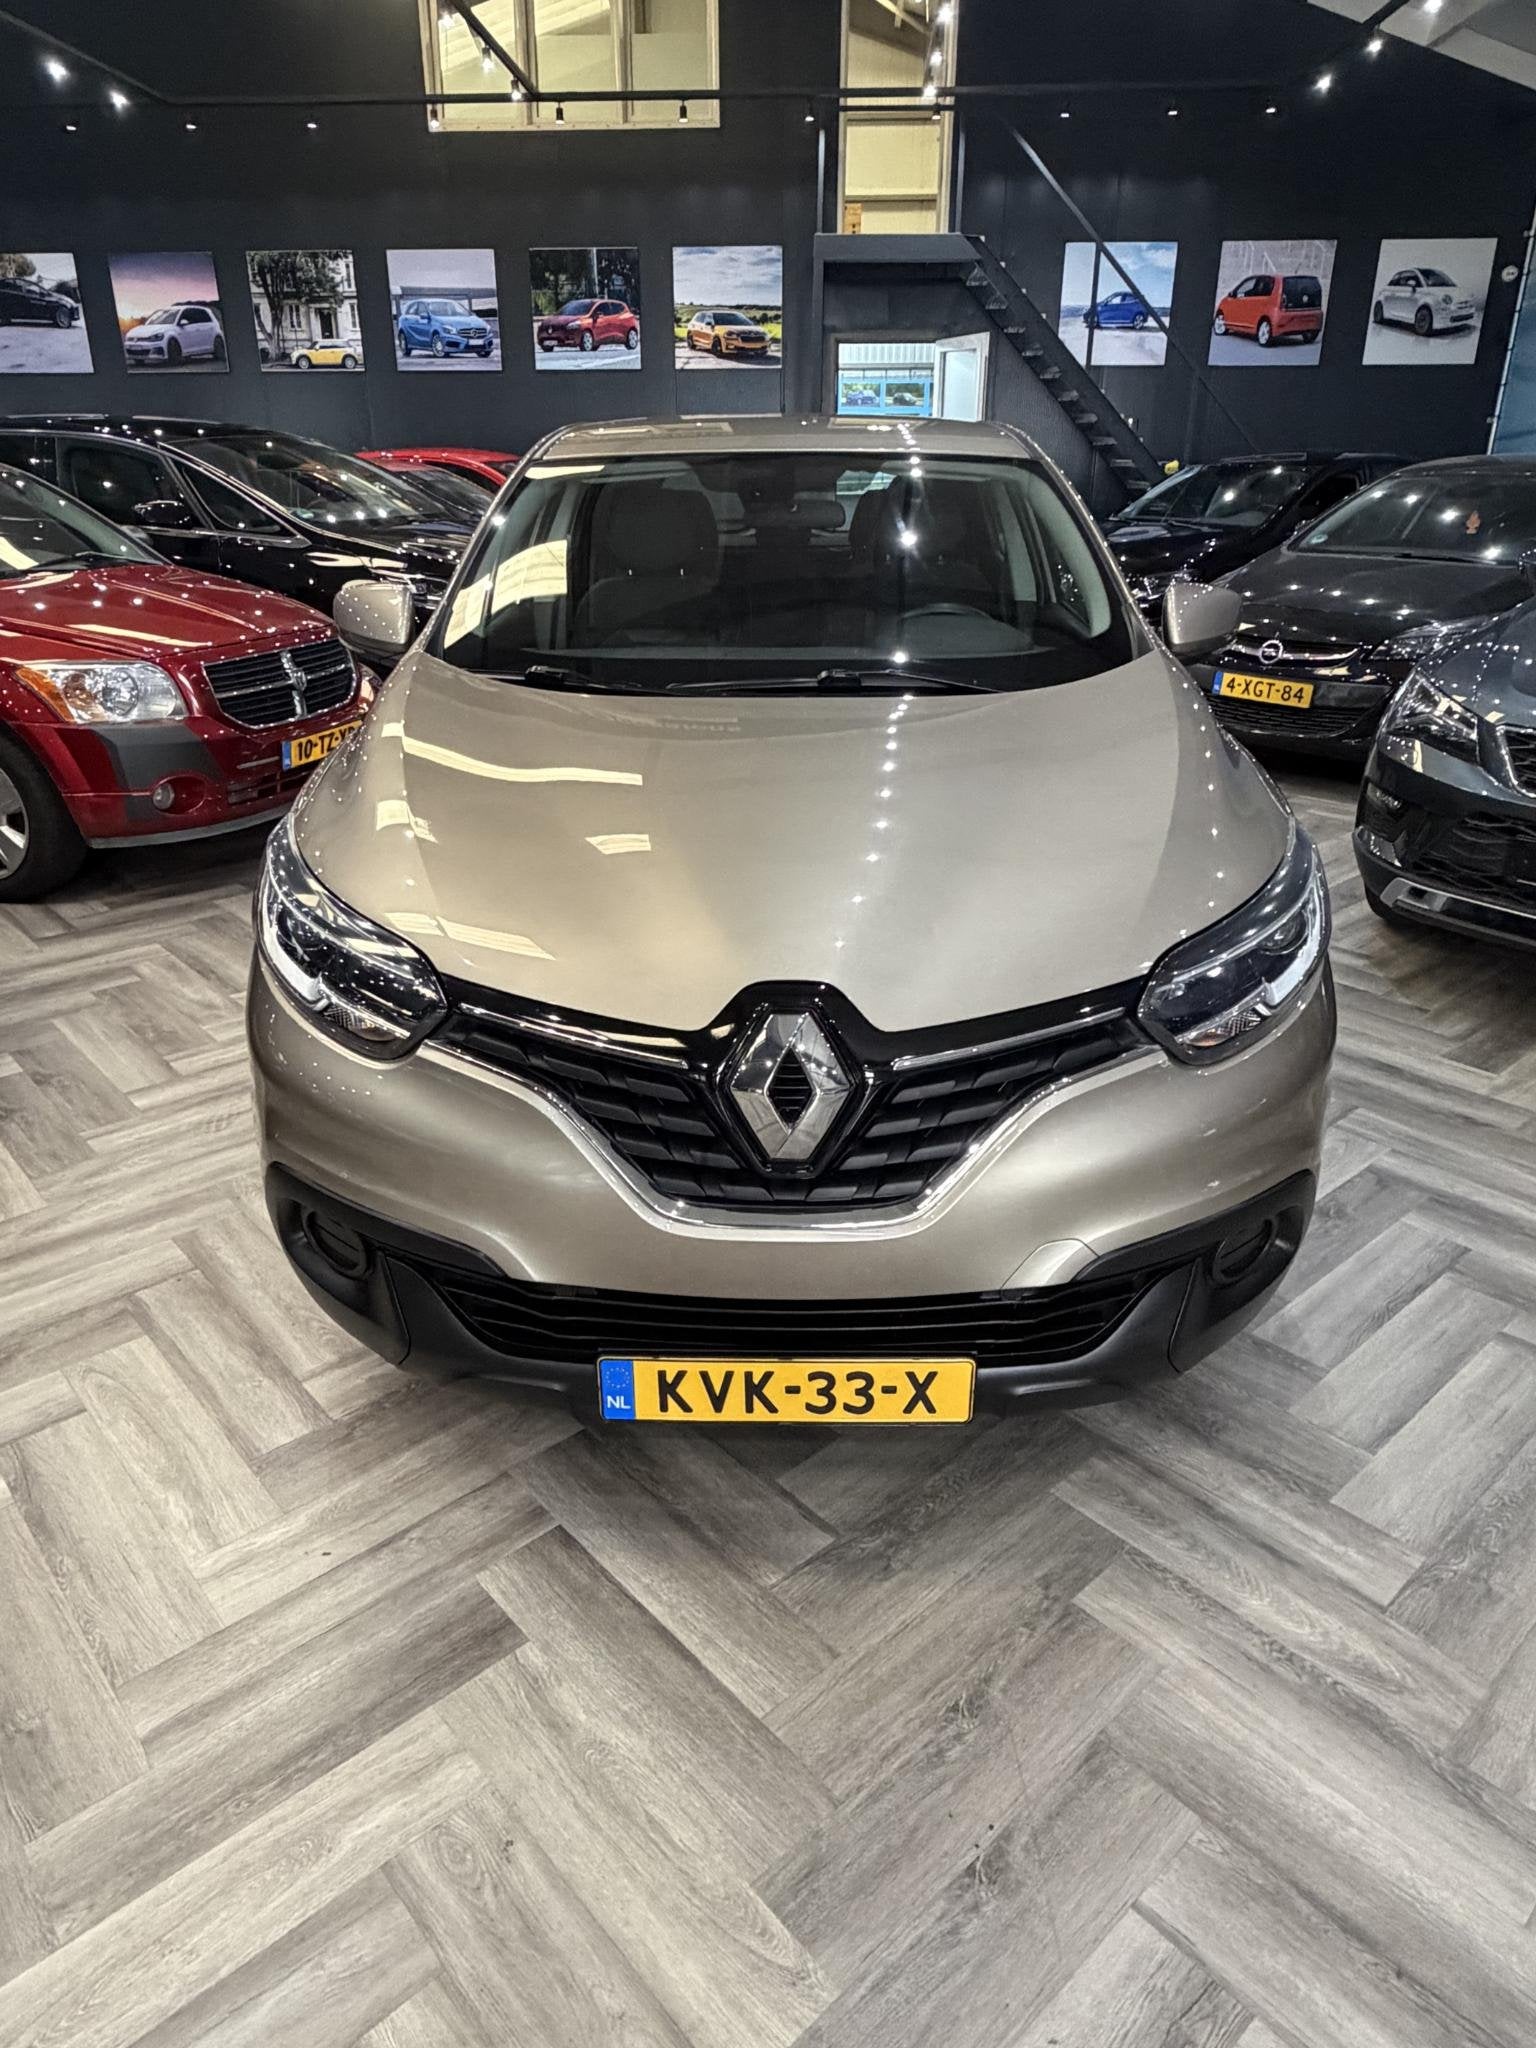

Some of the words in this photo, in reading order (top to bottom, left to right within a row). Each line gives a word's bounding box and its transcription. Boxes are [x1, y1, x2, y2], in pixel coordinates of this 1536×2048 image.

[1226, 676, 1305, 704] 4-XGT-84
[607, 1395, 631, 1410] NL
[656, 1369, 939, 1415] KVK-33-X
